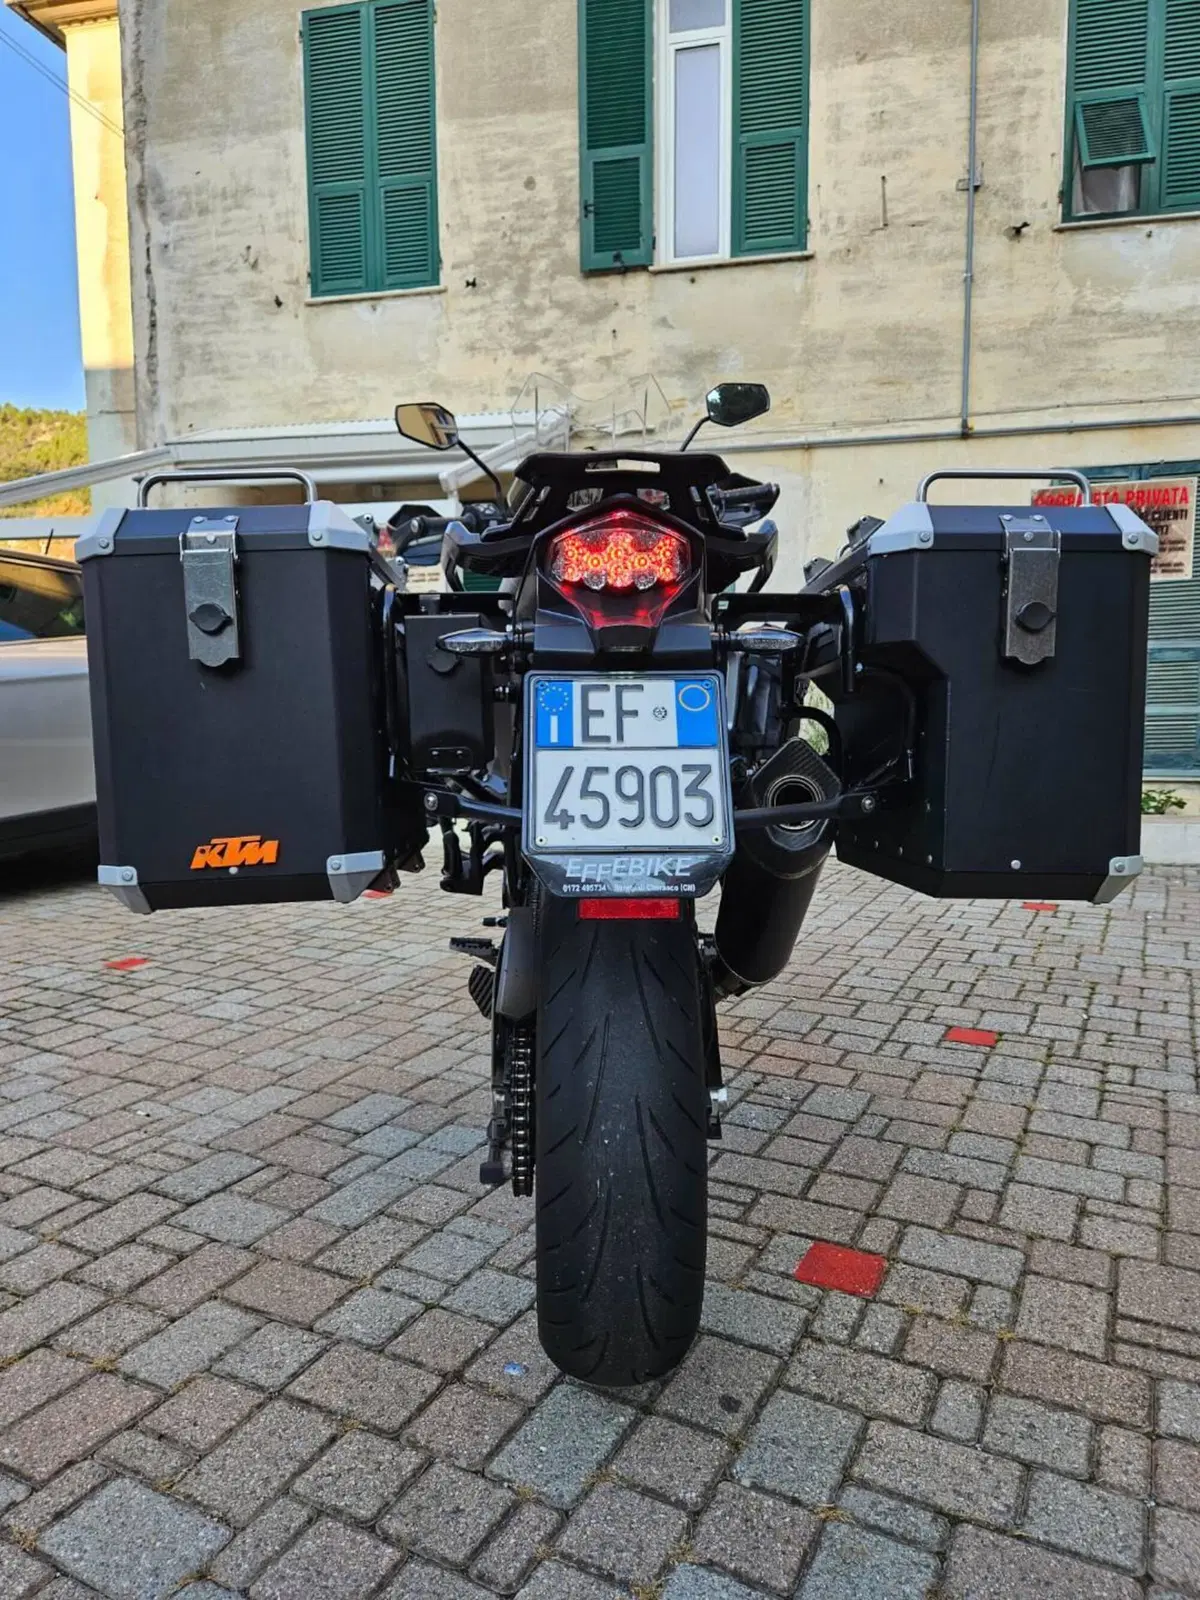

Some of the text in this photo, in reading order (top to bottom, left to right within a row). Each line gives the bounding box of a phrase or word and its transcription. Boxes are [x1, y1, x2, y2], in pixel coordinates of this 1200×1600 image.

[1125, 486, 1189, 506] PRIVATA
[550, 715, 559, 743] I
[580, 683, 644, 744] EF
[544, 764, 715, 830] 45903
[190, 835, 279, 869] KTM
[562, 884, 580, 892] 0172
